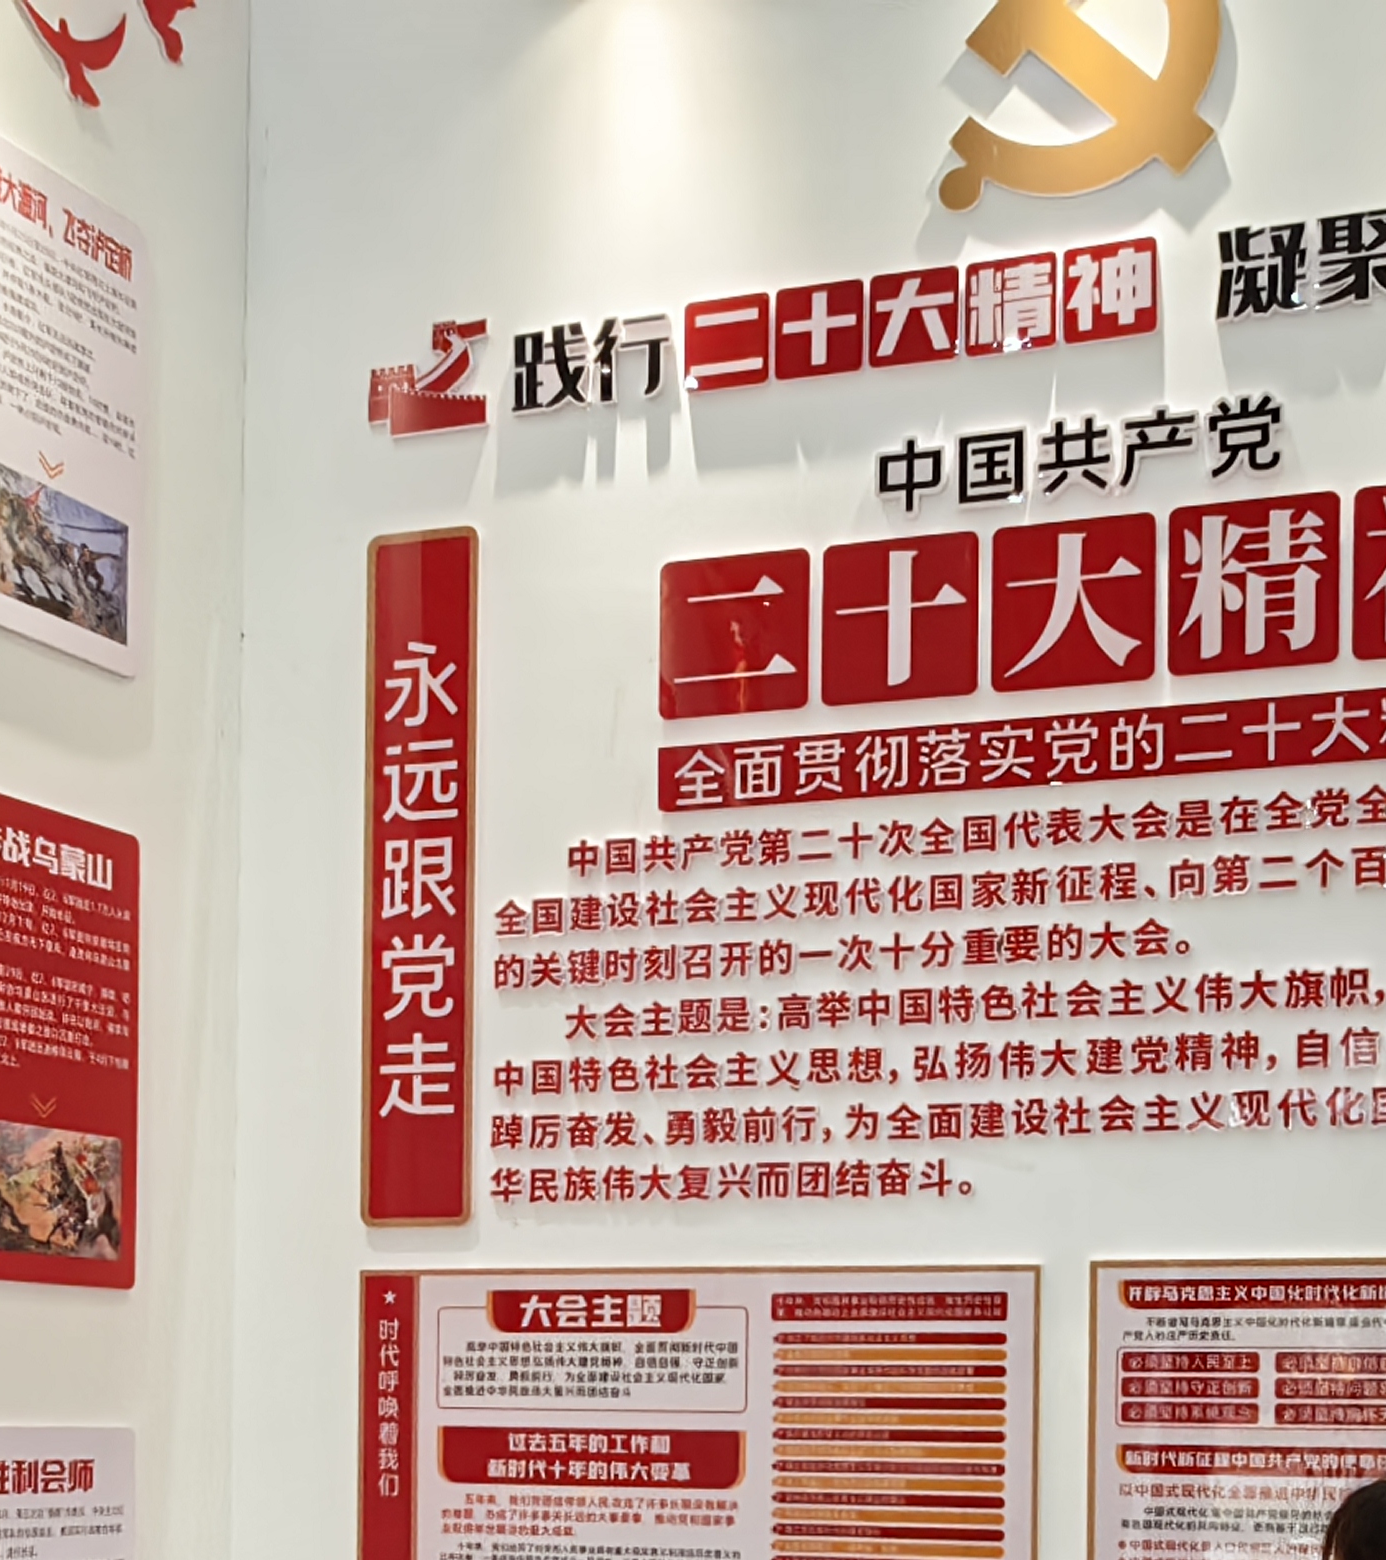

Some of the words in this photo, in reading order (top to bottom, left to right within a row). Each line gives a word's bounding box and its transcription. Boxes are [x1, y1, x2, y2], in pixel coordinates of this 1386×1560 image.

[511, 246, 1154, 413] 践行二十大精神
[877, 394, 1283, 513] 中国共产党
[379, 641, 459, 1118] 永远跟党走
[493, 919, 1191, 990] 的关键时刻召开的一次十分重要的大会。
[489, 1157, 975, 1205] 华民族伟大复兴而团结奋斗。
[519, 1294, 664, 1329] 大会主题
[378, 1318, 400, 1498] 时代呼唤着我们
[486, 1458, 692, 1482] 新时代十年的伟大变革
[507, 1432, 672, 1456] 过去五年的工作和
